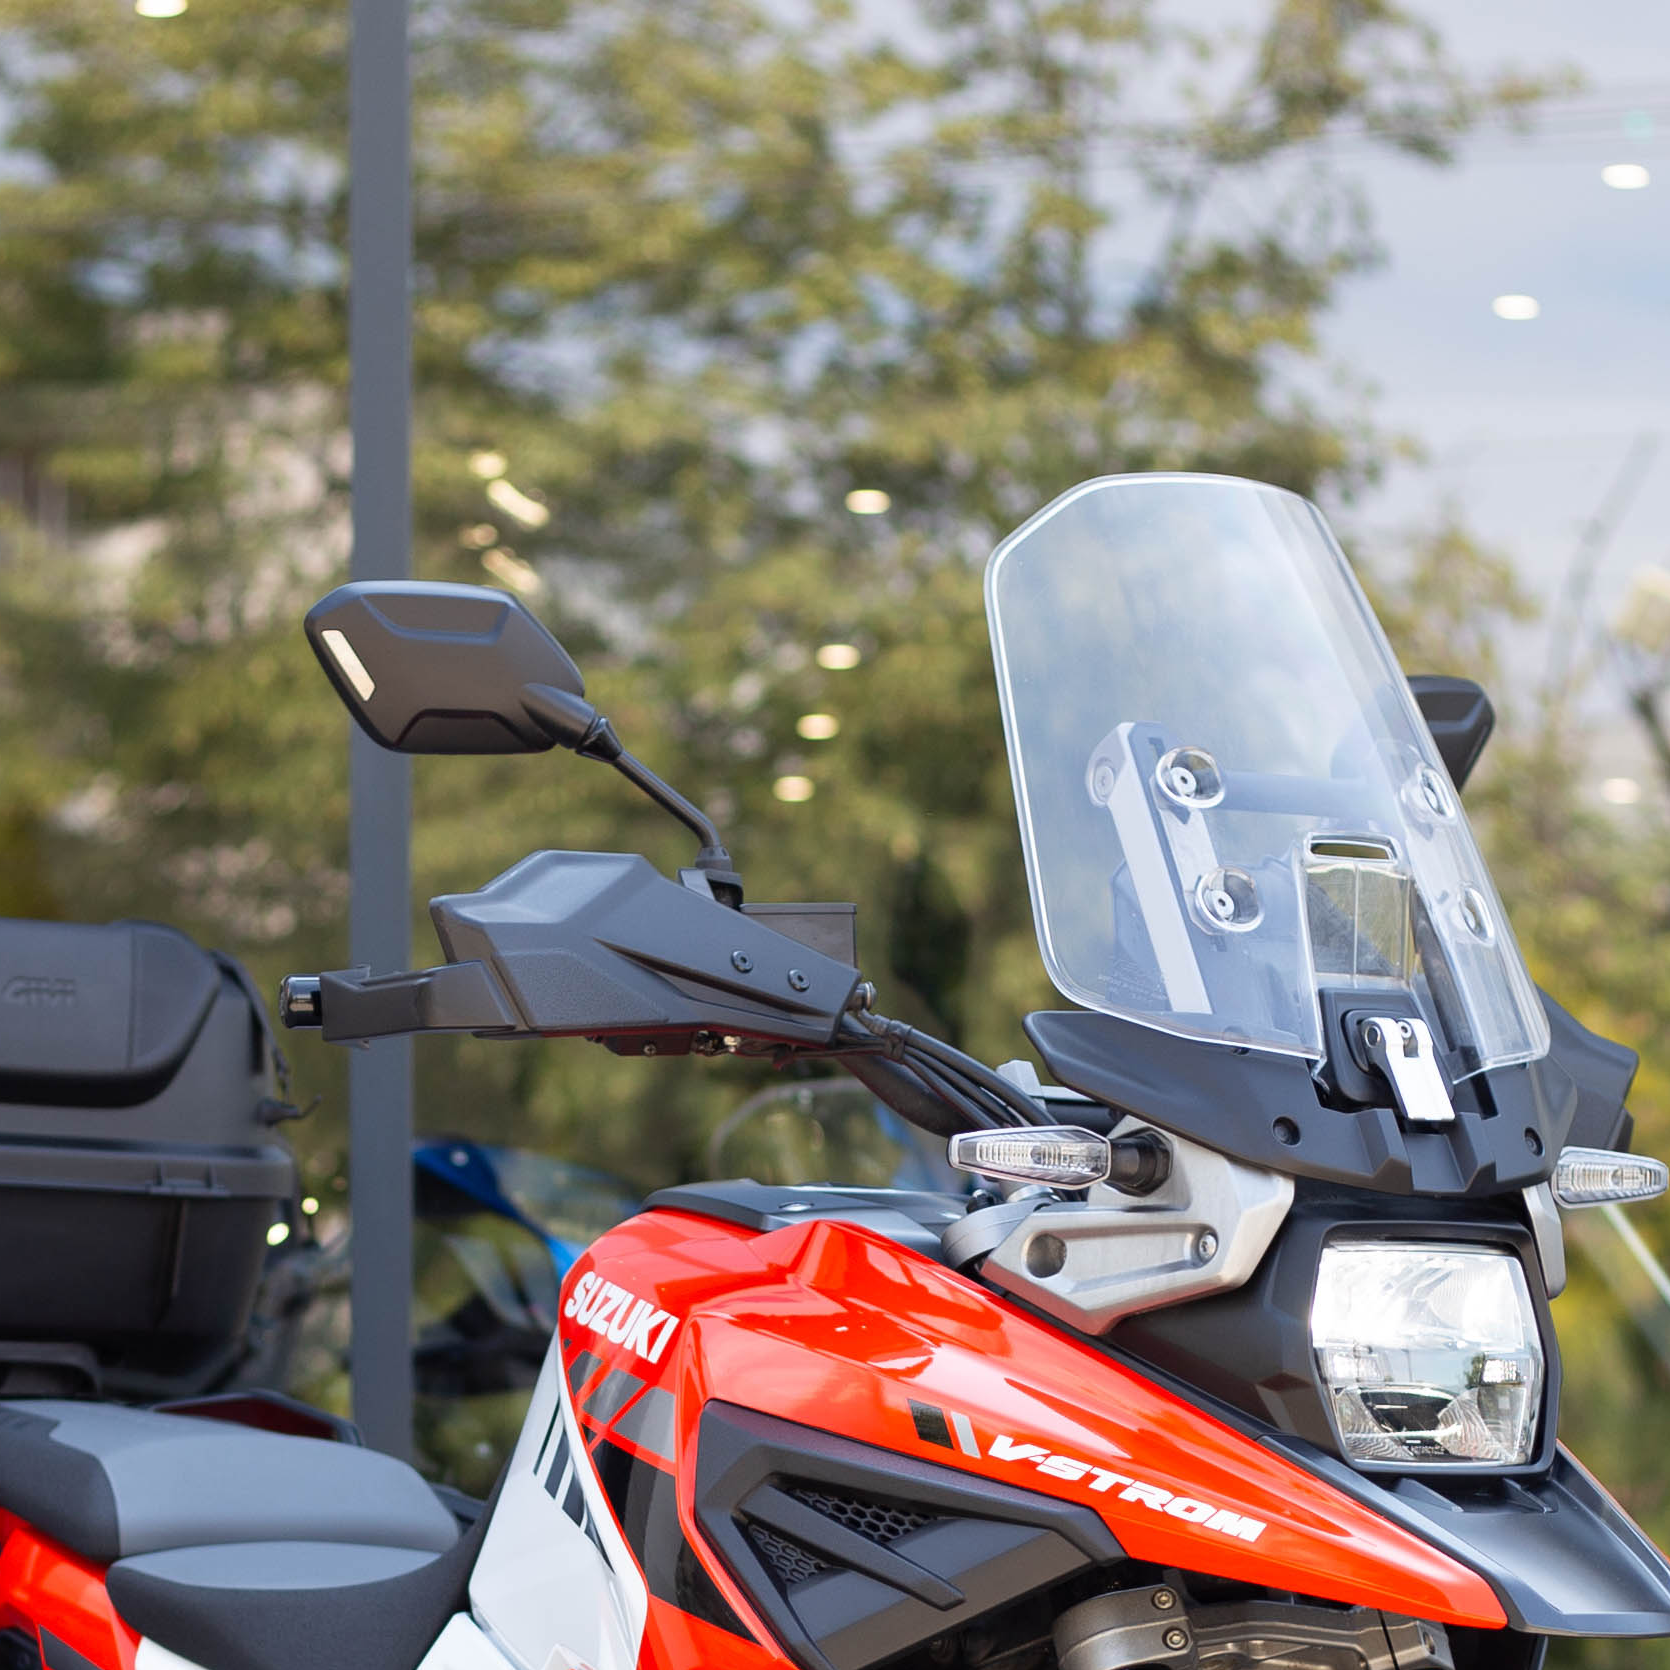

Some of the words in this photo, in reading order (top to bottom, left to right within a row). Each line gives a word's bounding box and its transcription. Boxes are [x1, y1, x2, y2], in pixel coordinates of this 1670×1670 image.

[2, 976, 77, 1007] GIVI
[564, 1271, 680, 1364] SUZUKI
[988, 1434, 1267, 1542] V-STROM
